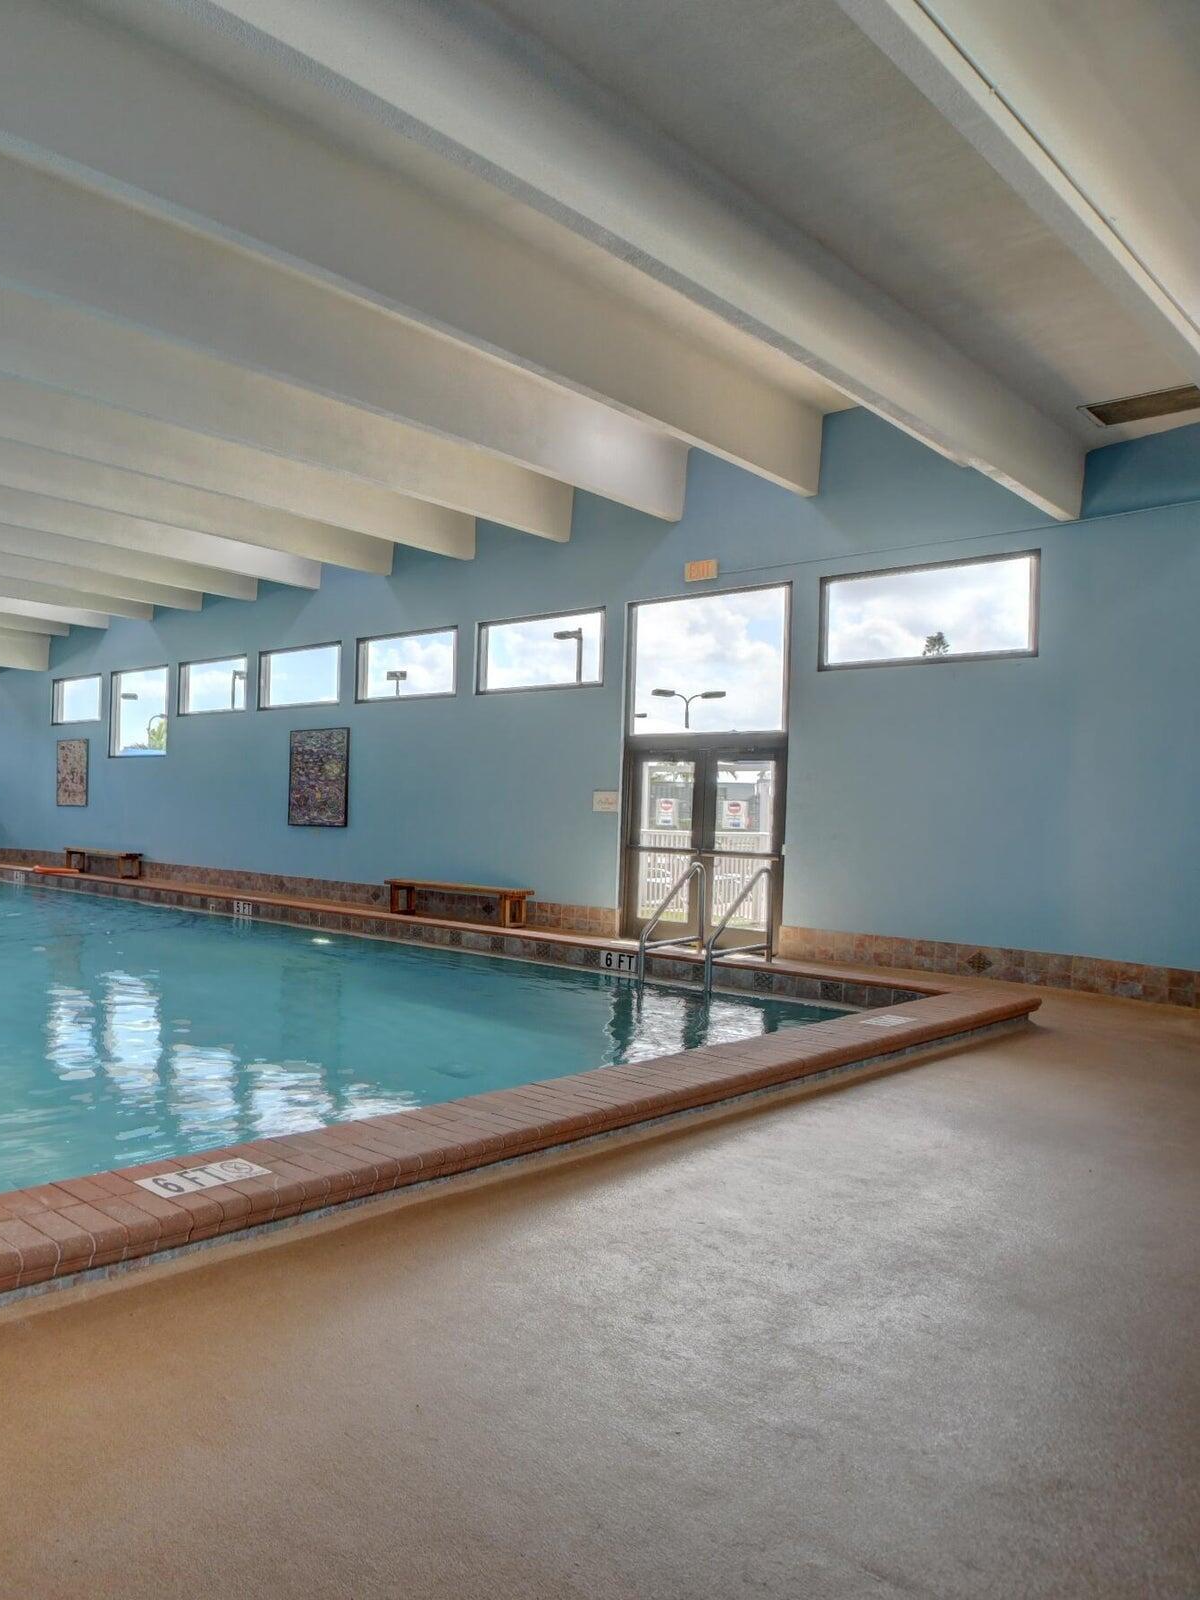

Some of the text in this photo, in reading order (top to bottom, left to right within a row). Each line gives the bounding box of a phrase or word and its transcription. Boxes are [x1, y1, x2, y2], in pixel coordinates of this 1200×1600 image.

[243, 902, 251, 914] FT
[605, 952, 635, 970] 6 FT
[152, 1177, 185, 1193] 6
[176, 1166, 228, 1187] FT
